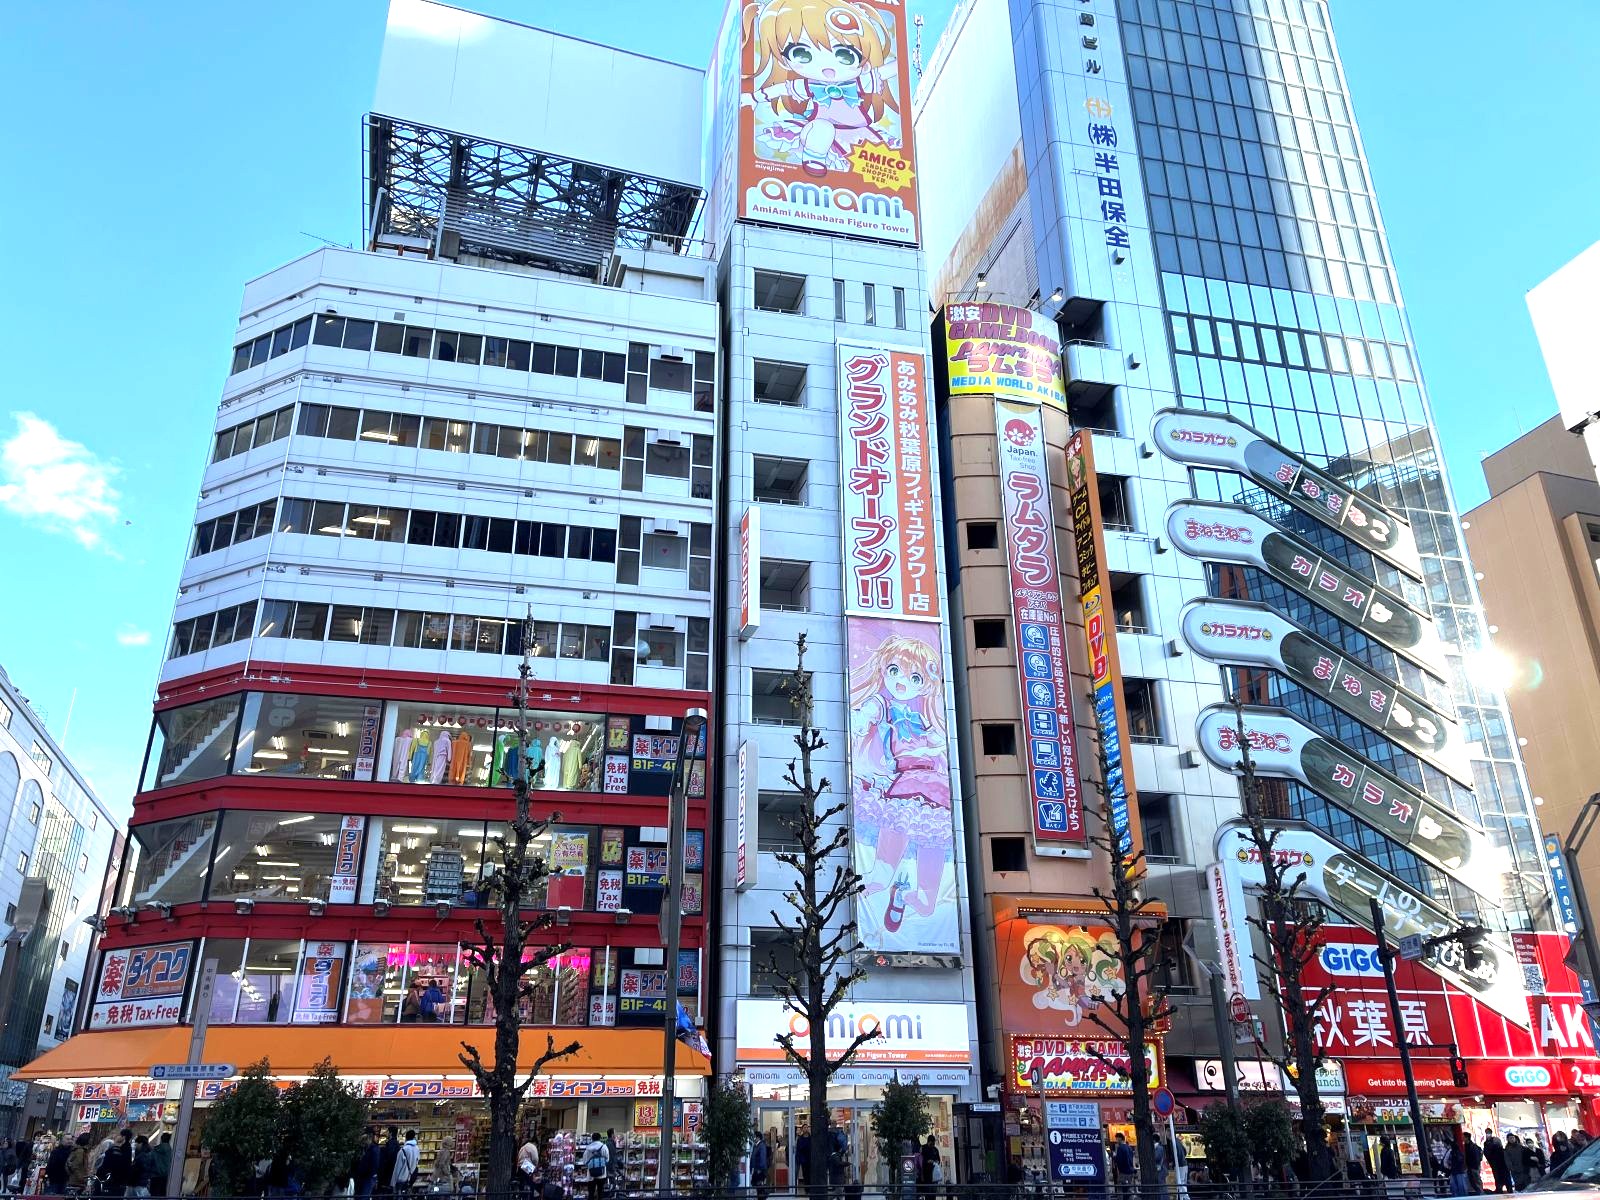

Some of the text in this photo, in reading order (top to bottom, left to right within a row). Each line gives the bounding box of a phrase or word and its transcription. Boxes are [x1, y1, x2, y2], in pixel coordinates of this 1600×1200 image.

[858, 150, 906, 170] AMICO
[865, 162, 897, 175] ENDLESS
[862, 167, 899, 182] SHOPPING
[1088, 123, 1131, 249] (株)半田保全
[761, 181, 900, 218] amiami
[752, 204, 909, 234] AmiAmi Akihabara Figure Tower
[950, 303, 1032, 329] 激安 DVD
[952, 376, 1065, 404] MEDIA WORLD AKIBA
[1179, 430, 1227, 446] カラオケ
[897, 361, 930, 612] あみあみ秋葉原フィギュアタワー店
[1073, 488, 1087, 506] ゲーム
[1075, 504, 1087, 519] CD
[1008, 471, 1053, 586] ラムタラ
[1185, 519, 1254, 544] まねきねこ
[1077, 527, 1092, 550] アニメ
[1079, 544, 1094, 563] コミック
[1211, 623, 1263, 640] カラオケ
[1088, 614, 1109, 683] DVD
[636, 737, 650, 755] 薬
[1217, 726, 1292, 753] まきねこ
[606, 762, 627, 774] 免税
[605, 782, 627, 791] Free
[608, 775, 625, 784] Tax
[341, 831, 357, 873] ダイコク
[629, 850, 668, 869] 薬 ダイコ
[599, 878, 621, 890] 免税
[598, 900, 620, 909] Free
[601, 892, 618, 900] Tax
[1215, 877, 1228, 921] カラオケ
[101, 948, 190, 996] 薬 ダイコク
[309, 959, 335, 1008] ダイコク
[623, 973, 639, 993] 薬
[106, 1005, 179, 1024] 免税 Tax-Free
[1306, 1000, 1434, 1047] 秋葉原
[1033, 1039, 1066, 1056] DVD
[749, 1072, 780, 1080] amiami
[1317, 1078, 1341, 1087] unch
[1368, 1079, 1381, 1087] Get
[1382, 1079, 1396, 1087] into
[1413, 1079, 1435, 1088] aming
[1508, 1069, 1547, 1084] GiGO
[140, 1082, 156, 1097] 免税
[534, 1081, 549, 1095] 薬
[637, 1081, 660, 1095] 免税
[85, 1107, 99, 1119] B1F
